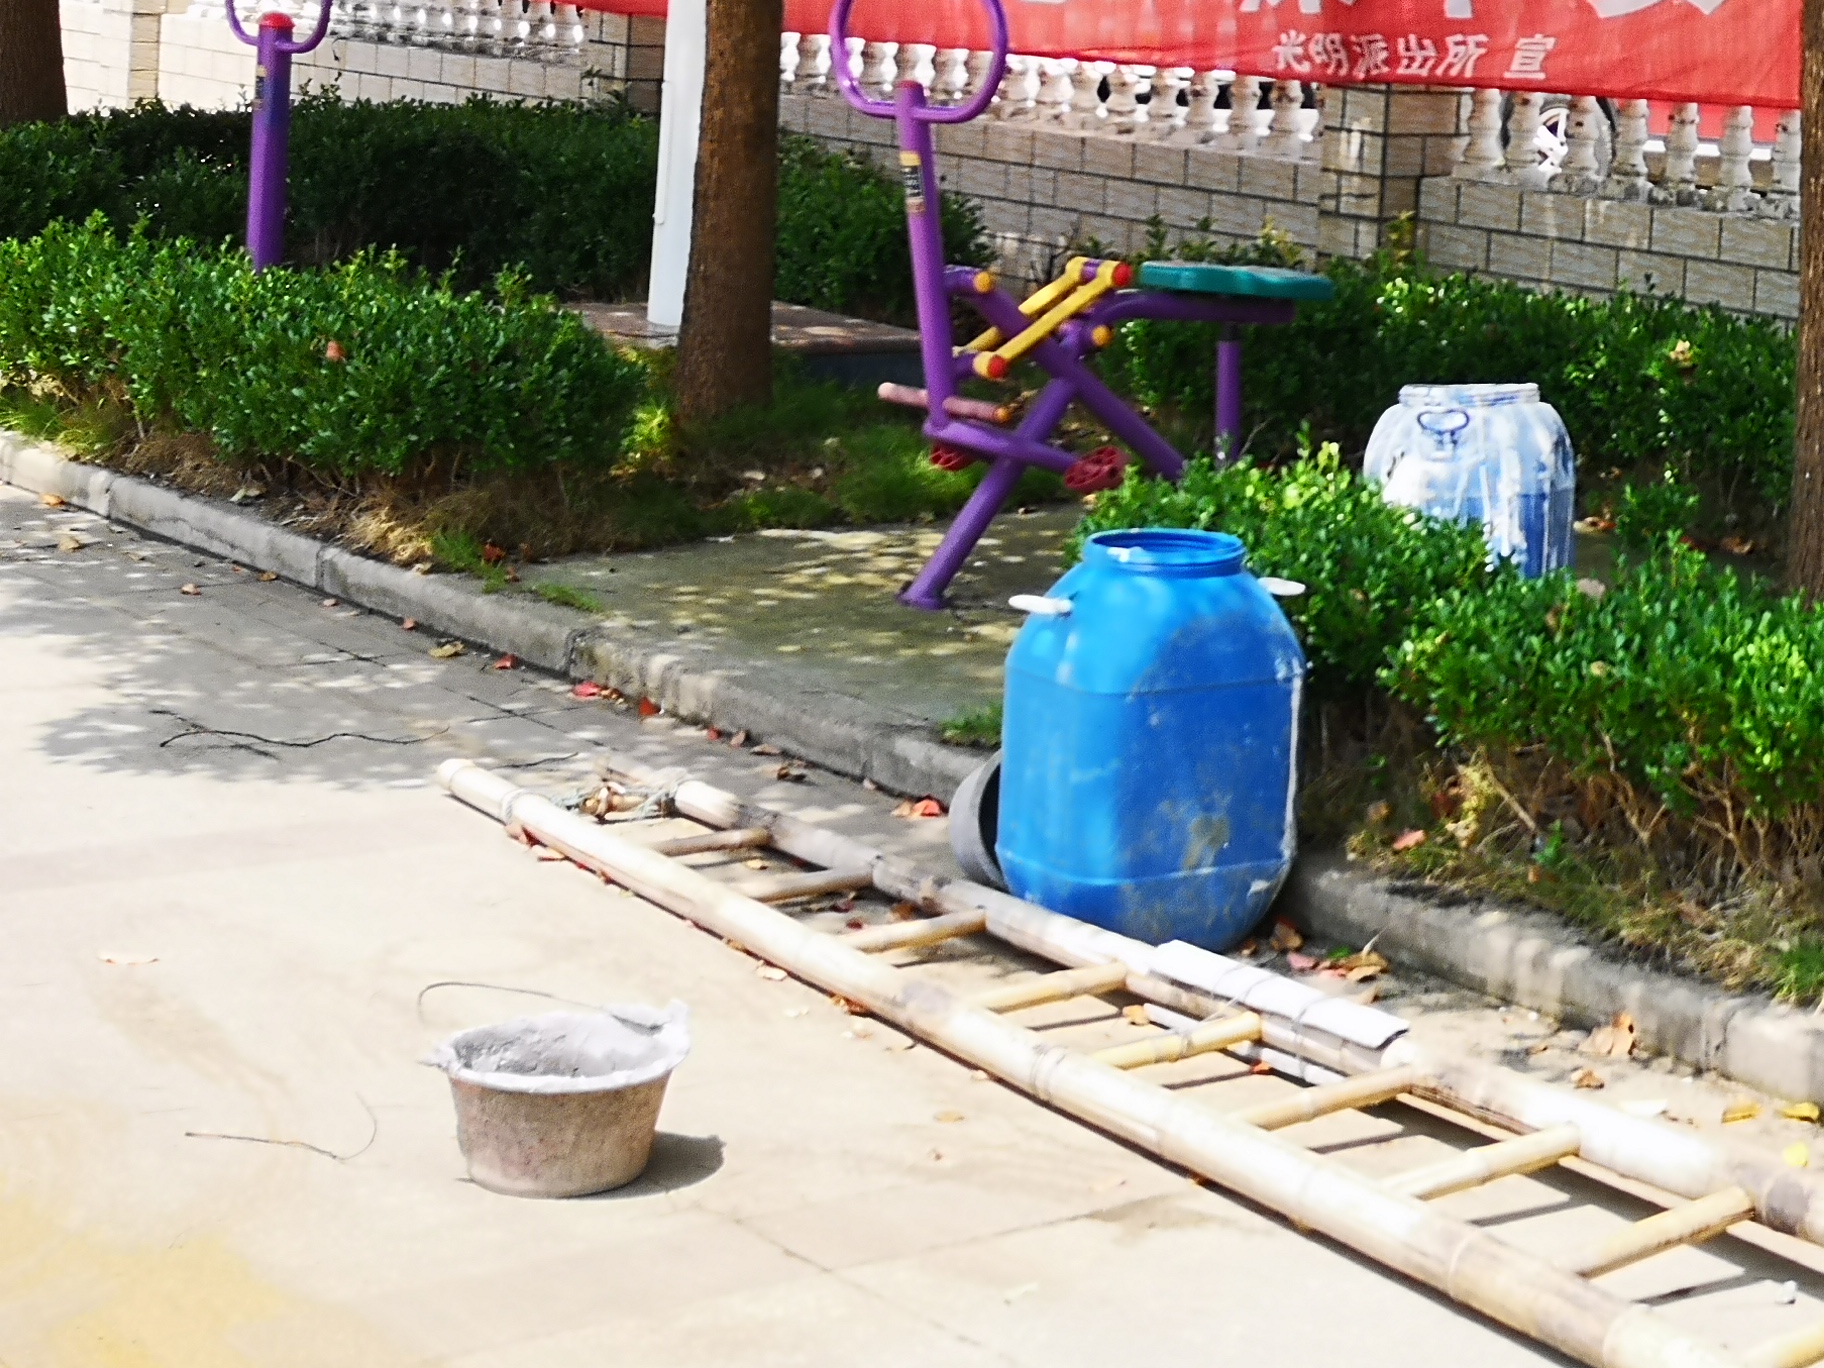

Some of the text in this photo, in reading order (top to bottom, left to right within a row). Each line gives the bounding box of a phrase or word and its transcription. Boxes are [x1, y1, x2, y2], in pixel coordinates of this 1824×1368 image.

[1271, 29, 1557, 80] 光明派出所 宣
